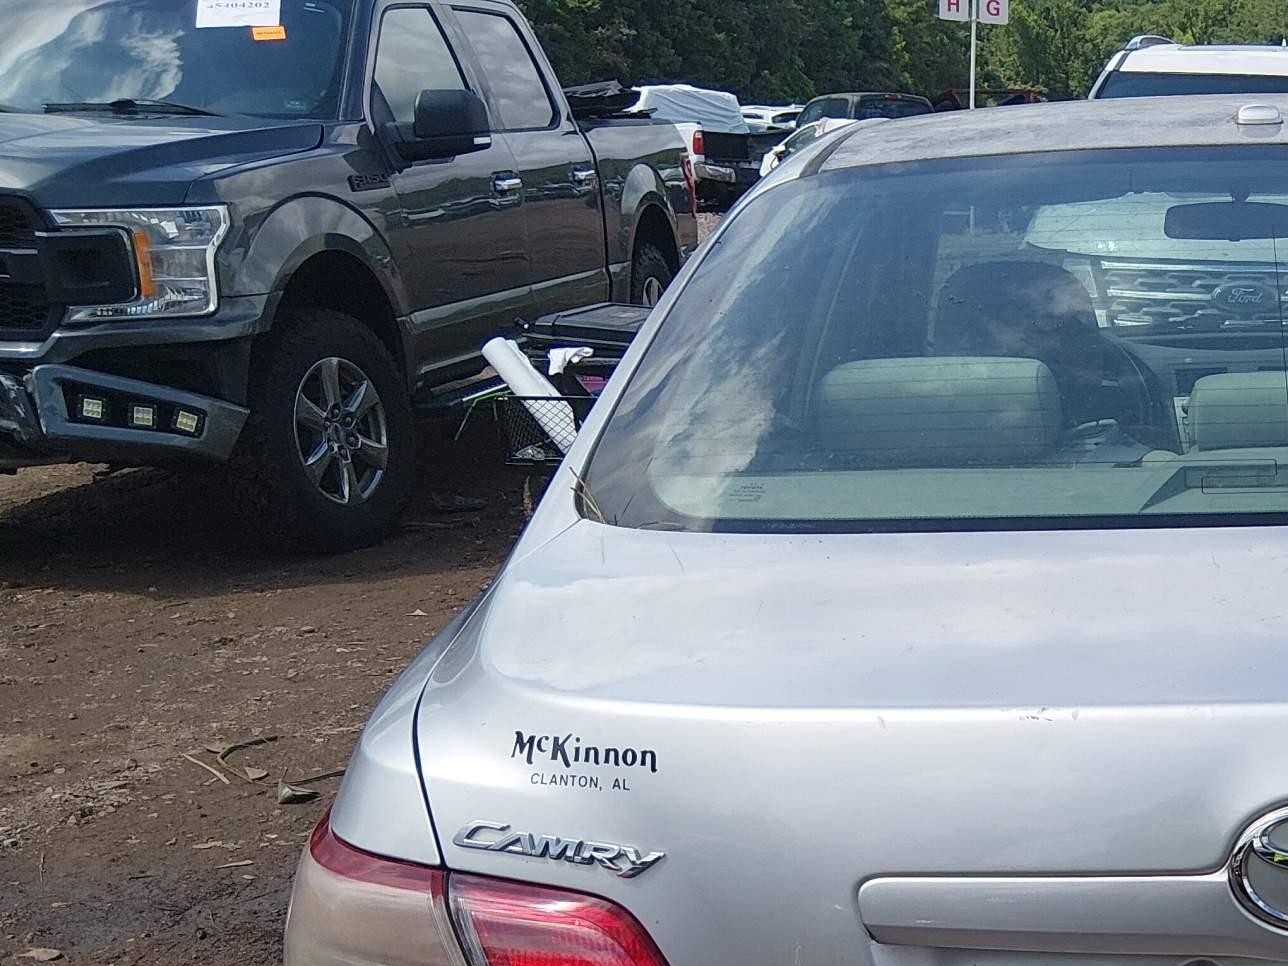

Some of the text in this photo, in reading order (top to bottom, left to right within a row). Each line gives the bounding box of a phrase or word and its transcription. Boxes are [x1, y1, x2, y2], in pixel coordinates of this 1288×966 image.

[947, 0, 960, 13] H
[986, 0, 1001, 16] G
[1227, 287, 1263, 304] Ford
[511, 730, 658, 773] McKinnon
[530, 772, 631, 791] CLANTON, AL
[452, 819, 667, 879] CAMRY
